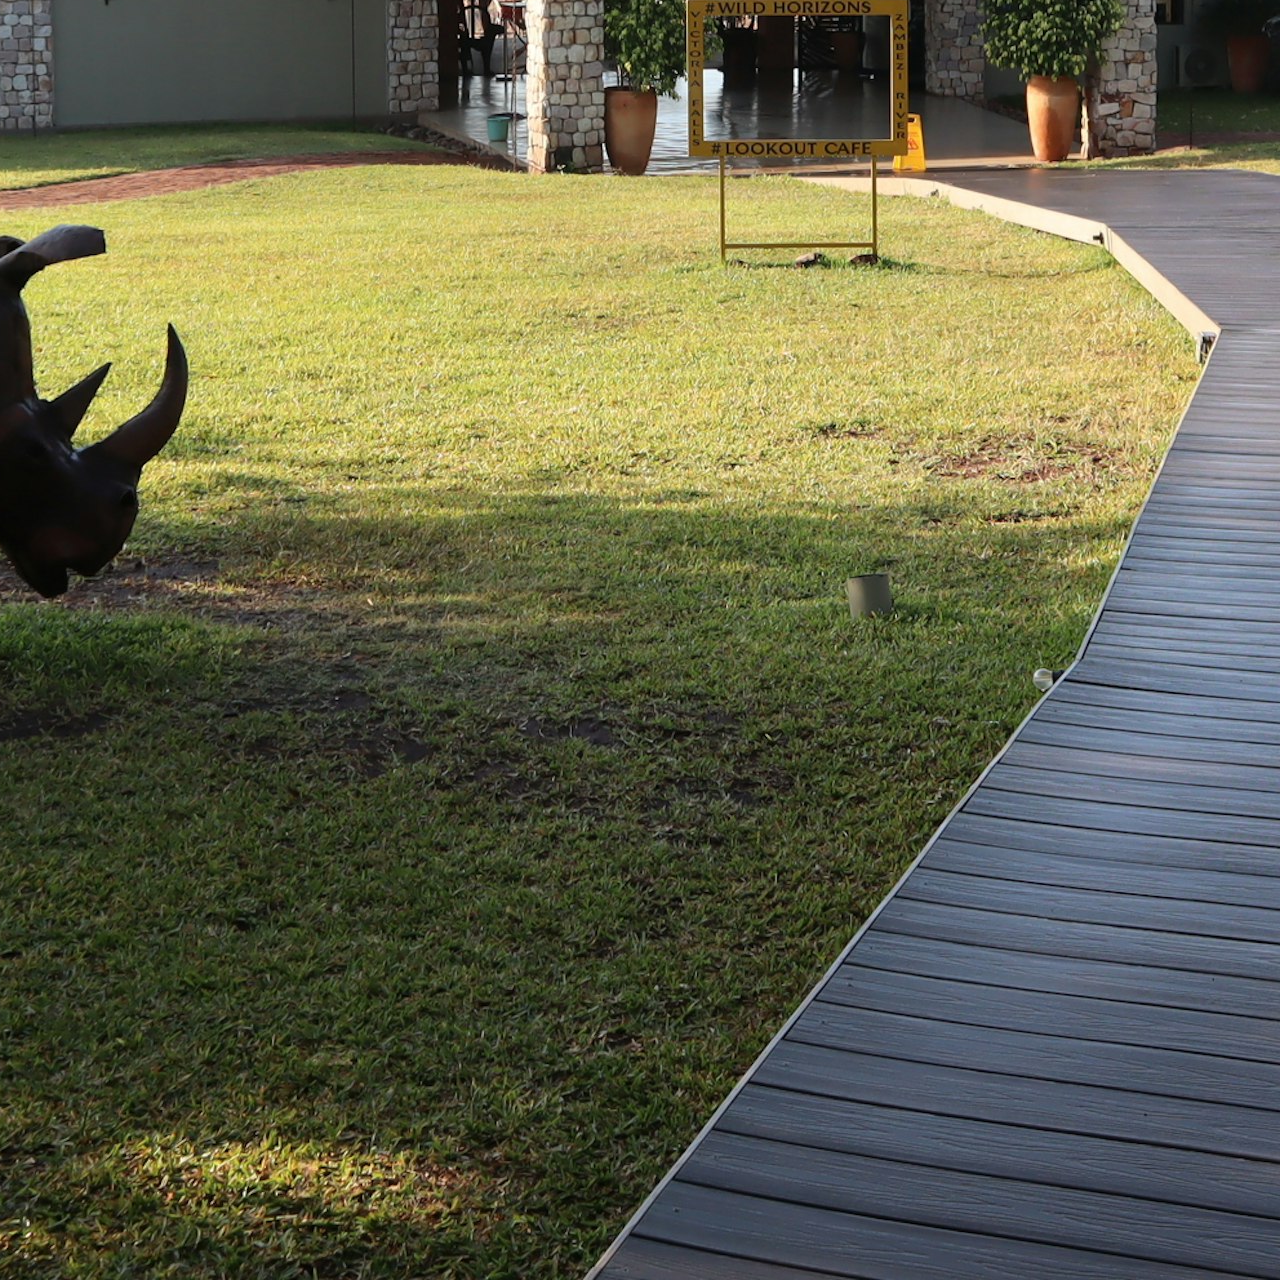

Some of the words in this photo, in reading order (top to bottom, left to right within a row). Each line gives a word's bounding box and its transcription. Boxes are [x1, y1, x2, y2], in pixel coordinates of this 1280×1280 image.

[705, 1, 766, 15] #WILD
[773, 0, 872, 14] HORIZONS
[690, 11, 702, 87] VICTORIA
[893, 14, 906, 81] ZAMBEZI
[691, 99, 701, 146] FALLS
[895, 92, 906, 139] RIVER
[824, 141, 872, 155] CAFE
